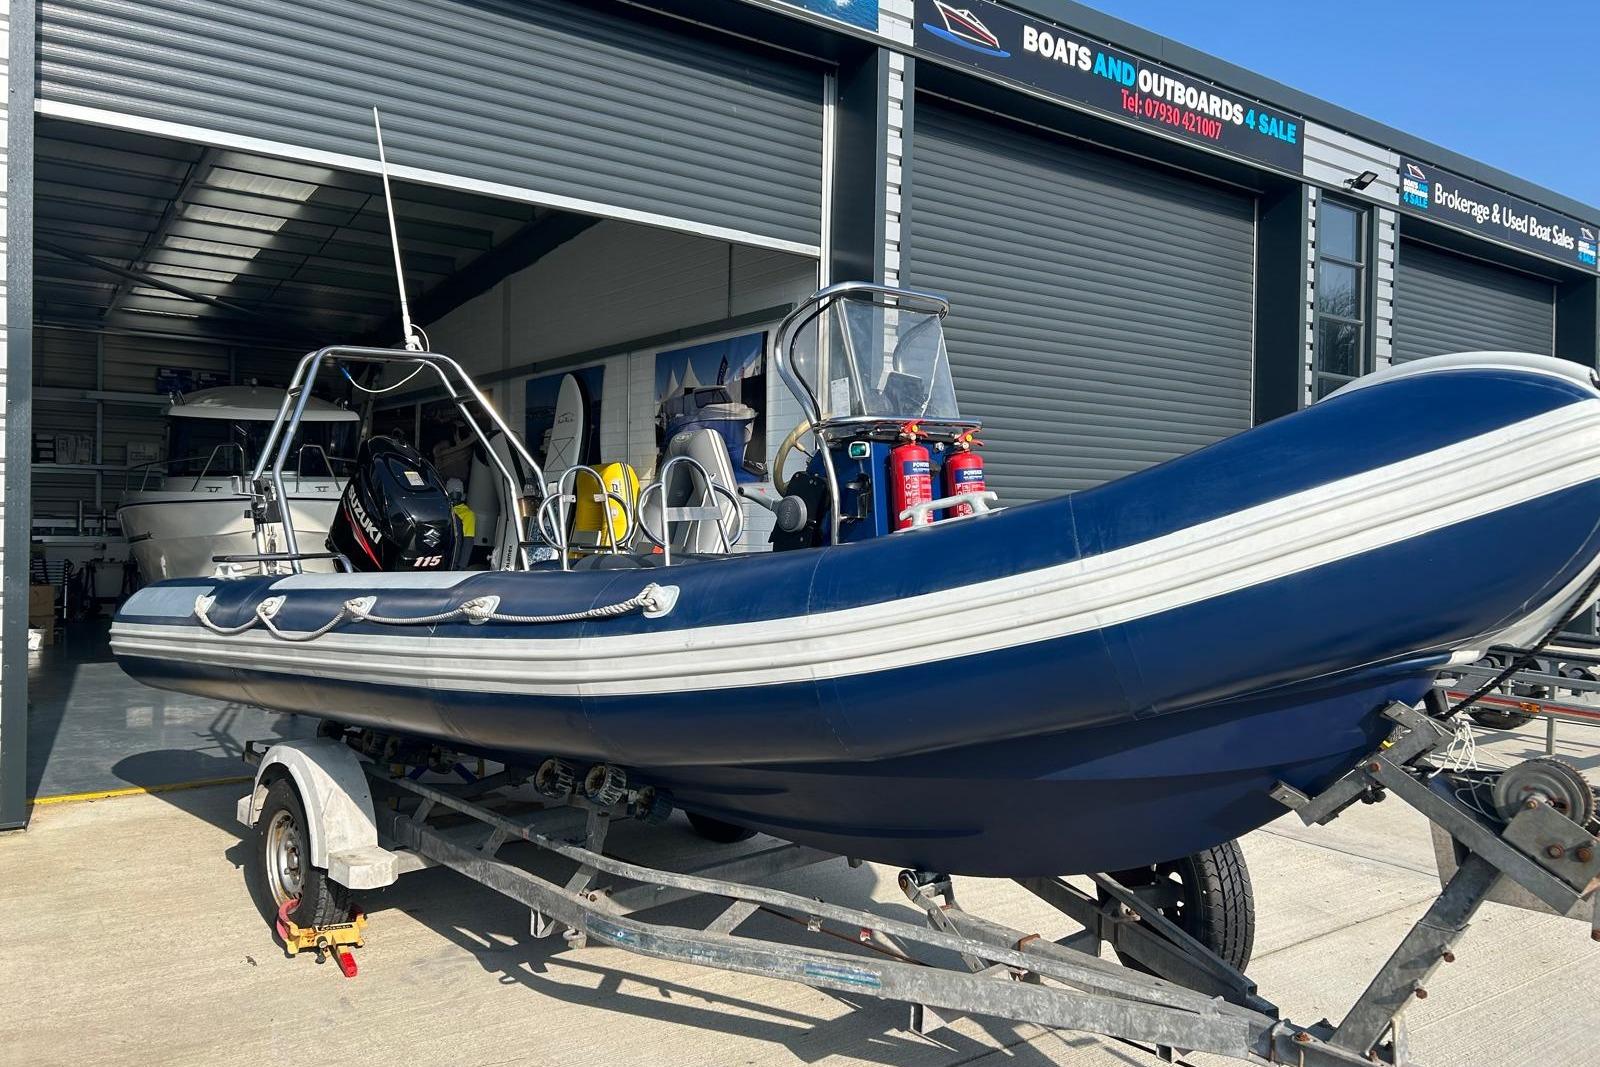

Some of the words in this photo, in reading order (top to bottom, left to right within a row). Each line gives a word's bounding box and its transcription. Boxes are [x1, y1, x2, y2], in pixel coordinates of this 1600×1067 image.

[1023, 25, 1092, 71] BOATS
[1093, 52, 1136, 87] AND
[1138, 69, 1244, 126] OUTBOARDS
[1245, 109, 1256, 130] 4
[1258, 112, 1297, 145] SALE
[1121, 89, 1143, 115] Tel:
[1144, 97, 1180, 126] 07930
[1181, 111, 1223, 140] 421007
[1434, 182, 1490, 224] Brokerage
[1491, 203, 1501, 224] &
[1502, 206, 1528, 233] Used
[1529, 216, 1551, 242] Boat
[1552, 225, 1575, 250] Sales
[348, 484, 382, 544] SUZUKI
[414, 555, 442, 567] 115
